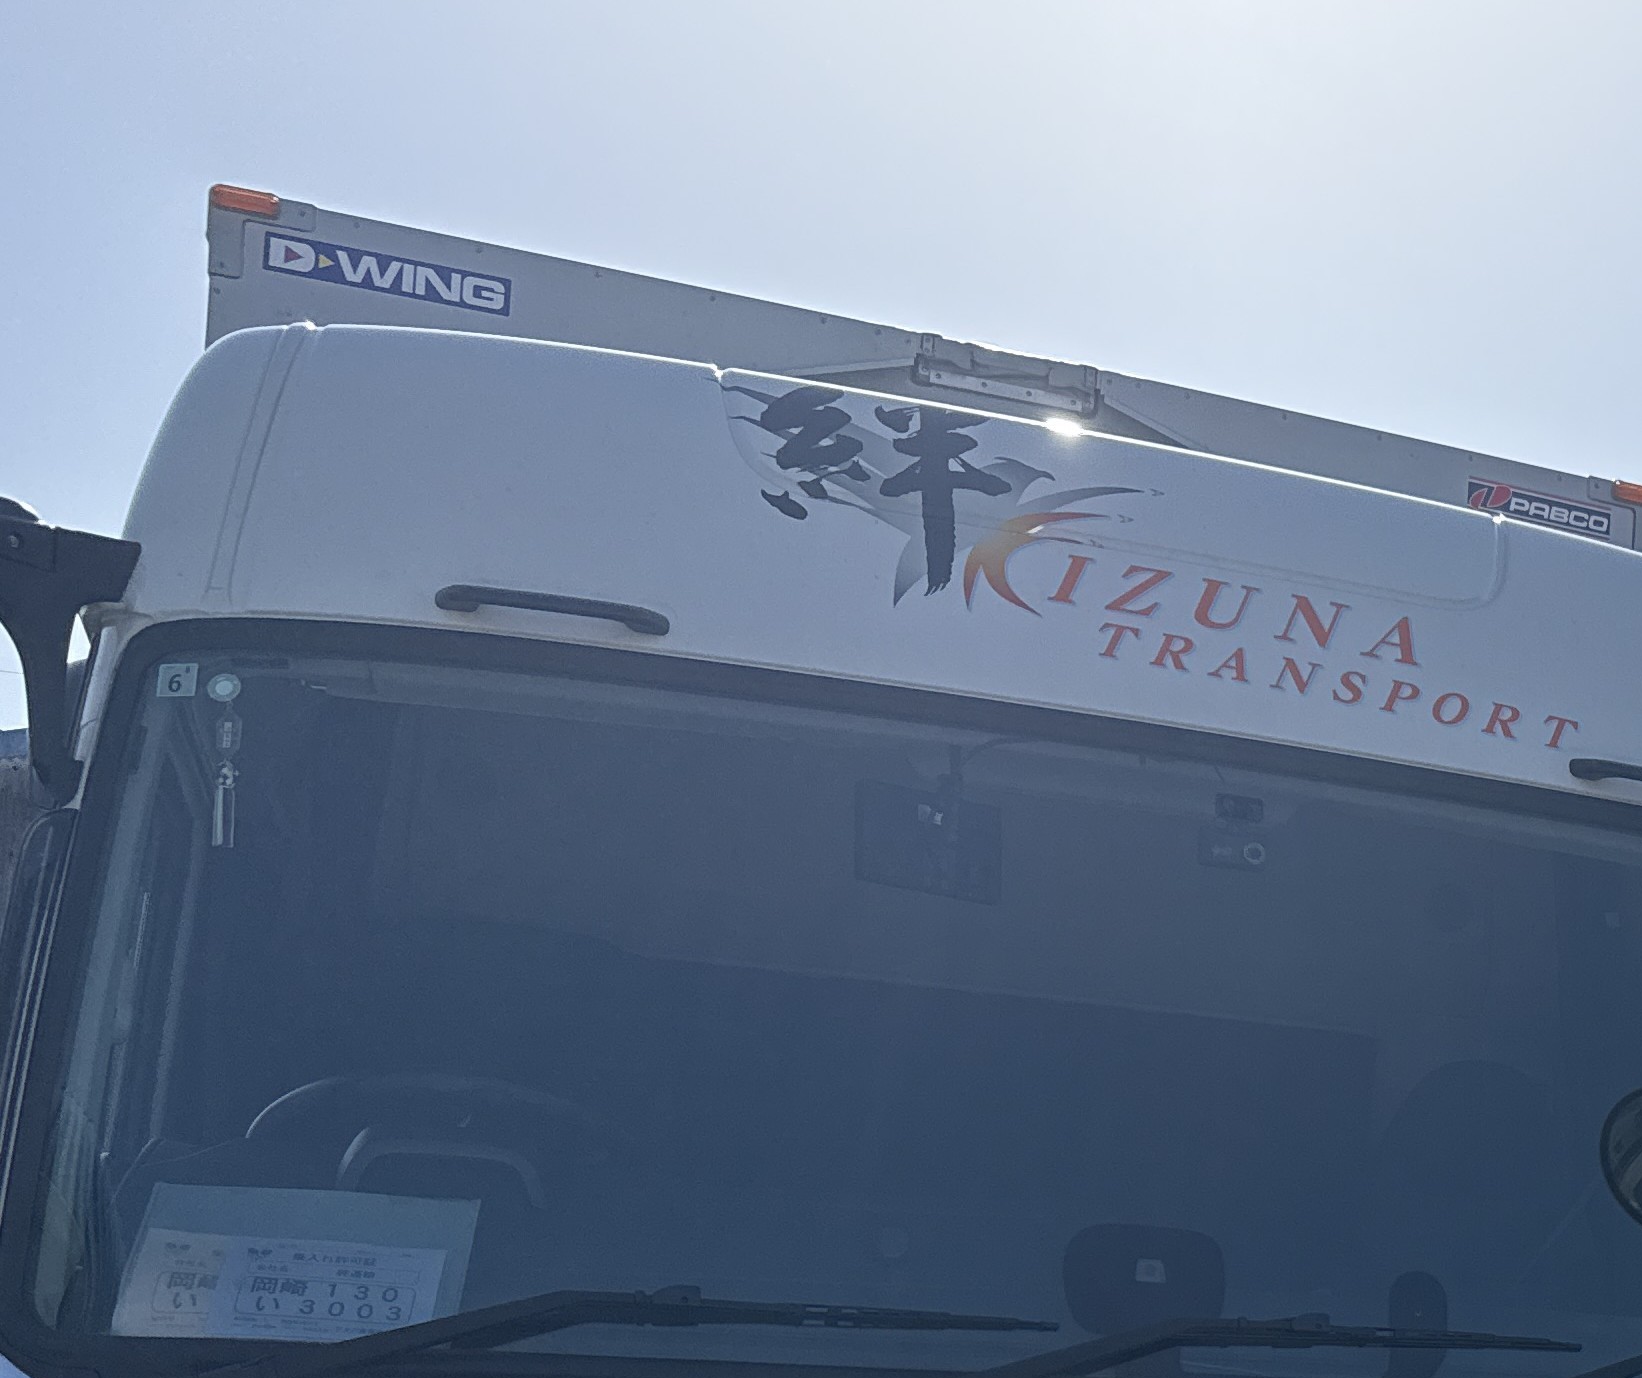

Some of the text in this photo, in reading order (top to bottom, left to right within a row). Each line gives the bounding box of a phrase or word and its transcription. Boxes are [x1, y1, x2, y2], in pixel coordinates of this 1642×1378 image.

[1509, 497, 1609, 532] PABCO
[1096, 622, 1580, 749] TRANSPORT
[299, 1299, 402, 1322] 3003
